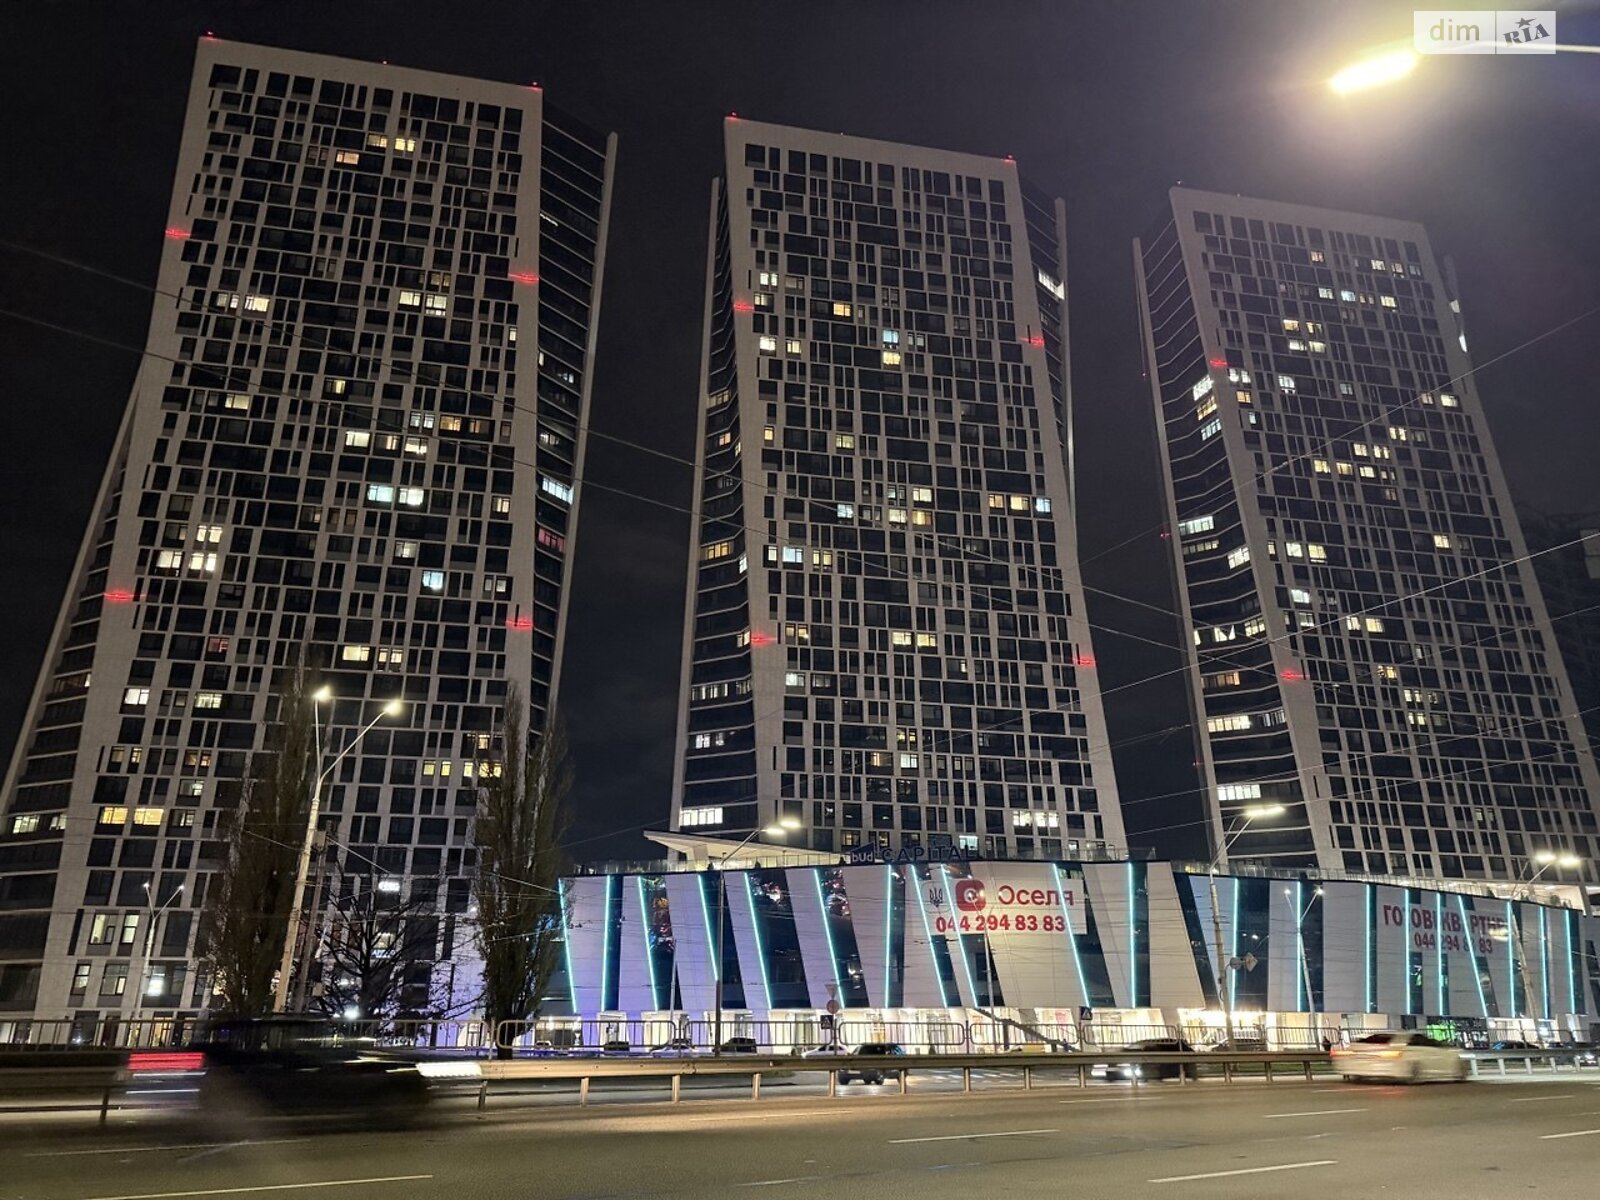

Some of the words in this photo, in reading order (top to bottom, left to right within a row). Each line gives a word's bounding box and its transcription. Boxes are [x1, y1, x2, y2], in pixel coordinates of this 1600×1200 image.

[882, 844, 978, 861] CAPITAL
[975, 914, 1010, 932] 294
[1015, 915, 1038, 931] 83
[1043, 915, 1065, 931] 83
